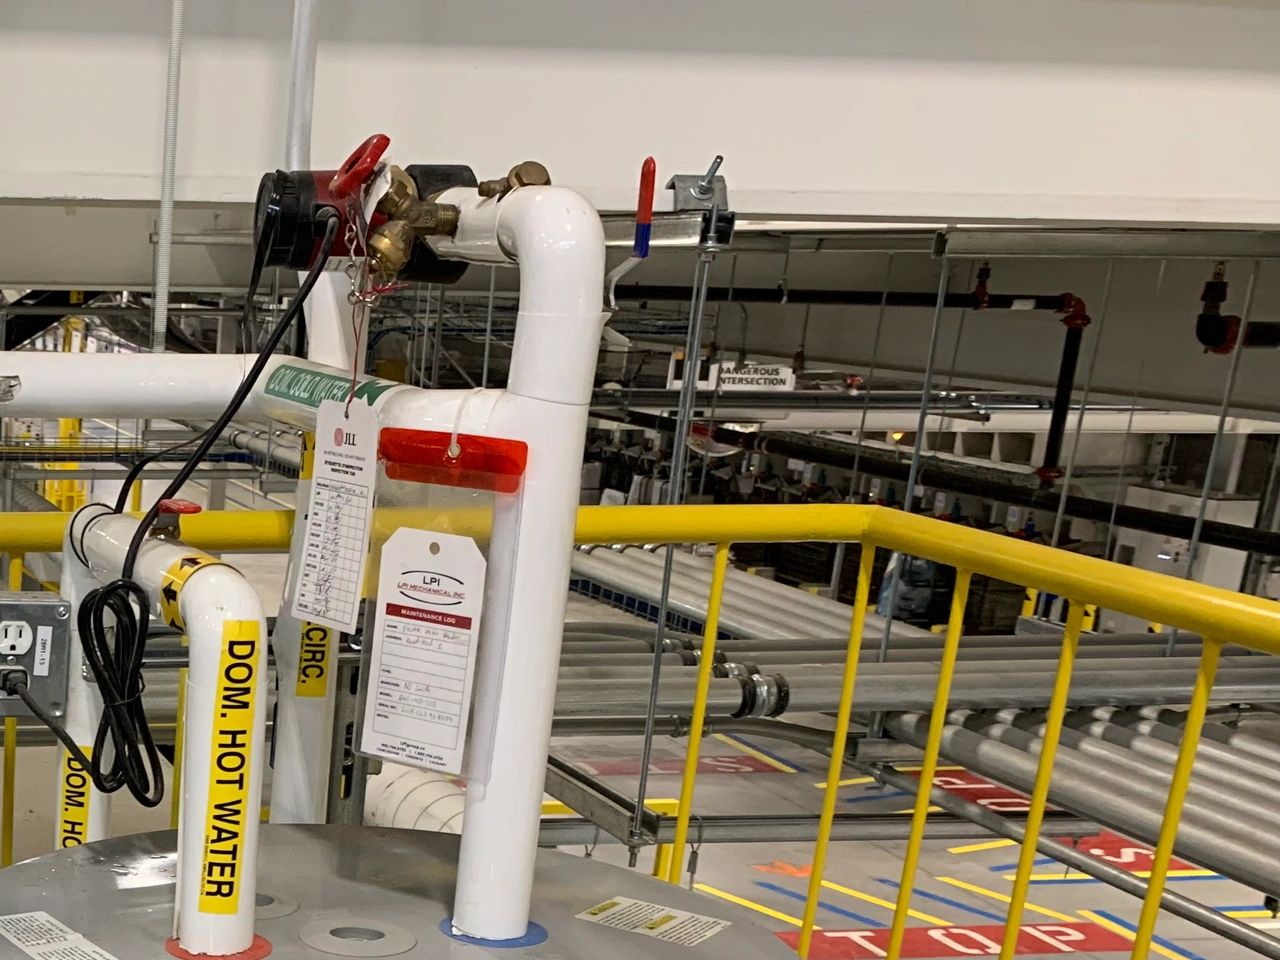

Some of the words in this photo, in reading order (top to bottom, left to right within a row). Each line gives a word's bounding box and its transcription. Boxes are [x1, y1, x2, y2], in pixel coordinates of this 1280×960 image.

[719, 367, 780, 376] DANGEROUS
[720, 377, 787, 386] NTERSECTION
[290, 373, 321, 398] COLD
[312, 378, 350, 402] WATER
[410, 584, 451, 597] MECHANICAL
[423, 576, 440, 586] LPI
[401, 609, 442, 621] MAINTENANCE
[301, 622, 327, 684] CIRC.
[220, 640, 256, 718] DOM.
[216, 730, 247, 790] HOT
[64, 757, 87, 812] DOM.
[205, 799, 242, 898] WATER
